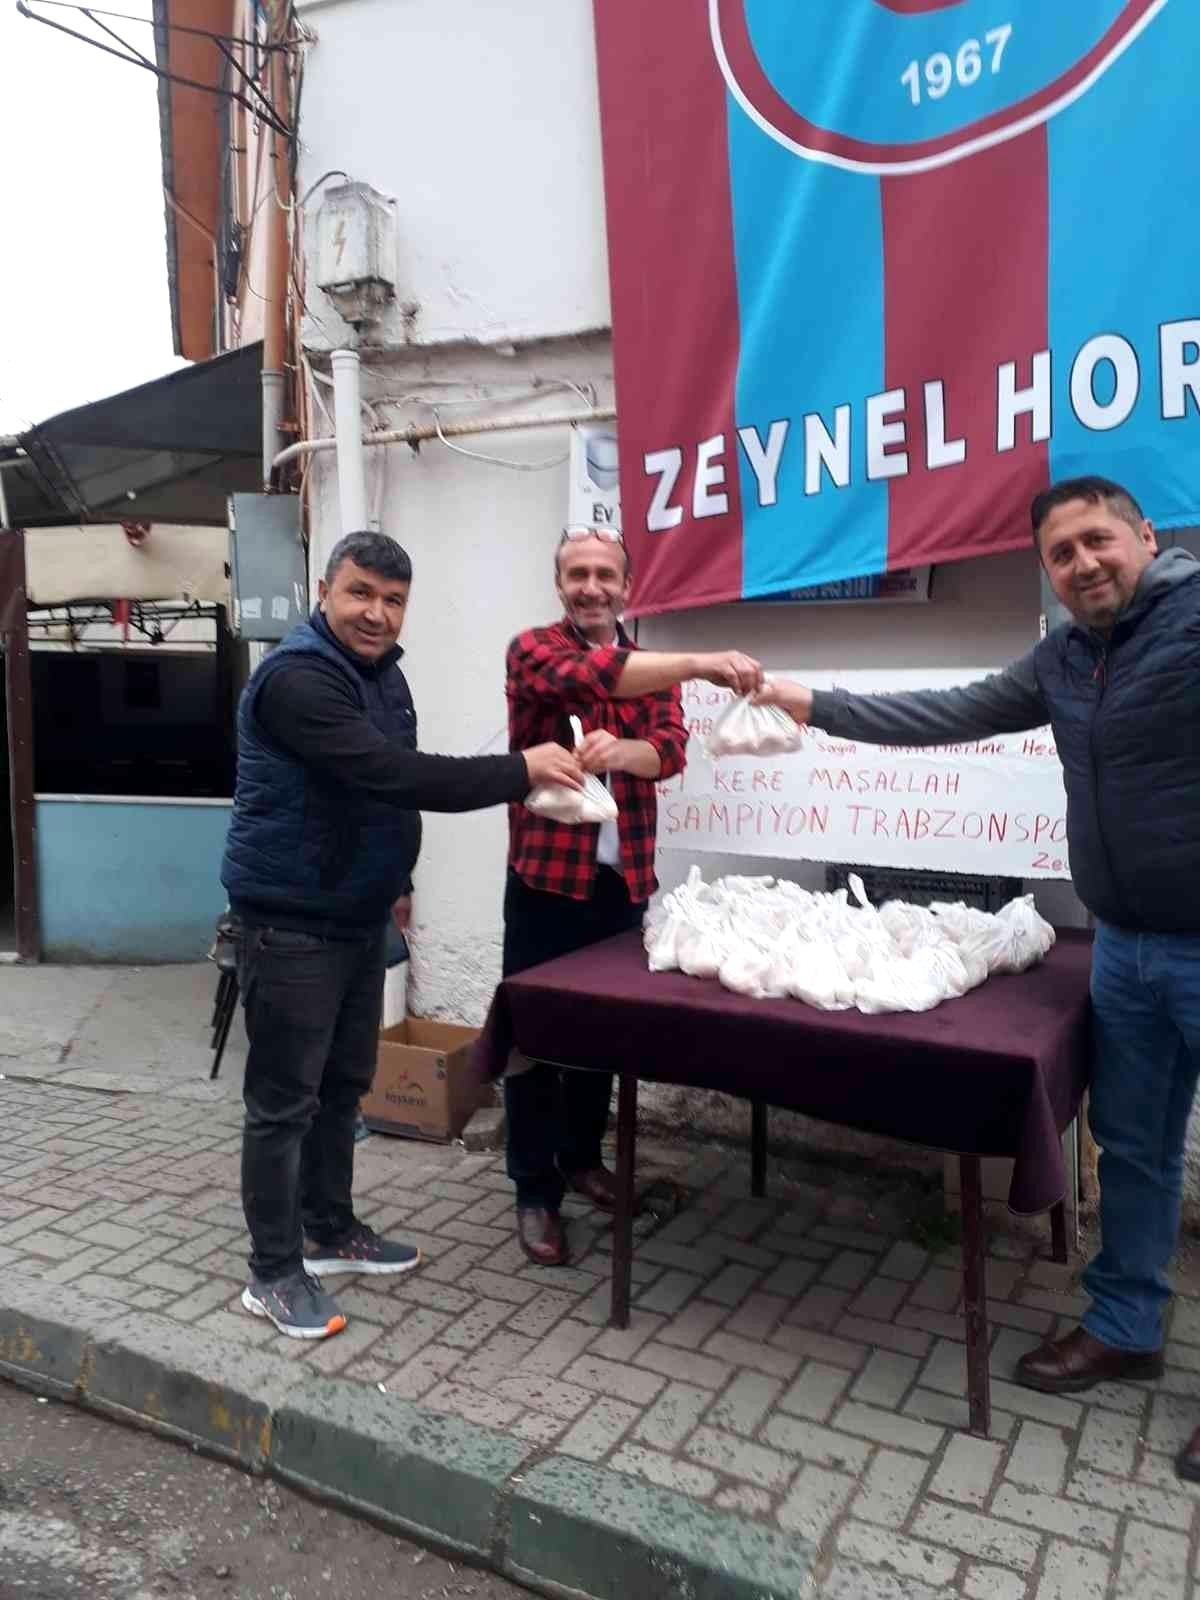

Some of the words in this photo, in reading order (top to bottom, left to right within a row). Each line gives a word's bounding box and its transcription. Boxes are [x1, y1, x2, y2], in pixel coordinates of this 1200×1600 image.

[900, 23, 1013, 105] 1967
[643, 378, 967, 533] ZEYNEL
[996, 317, 1200, 452] HOR
[714, 767, 785, 793] KERE
